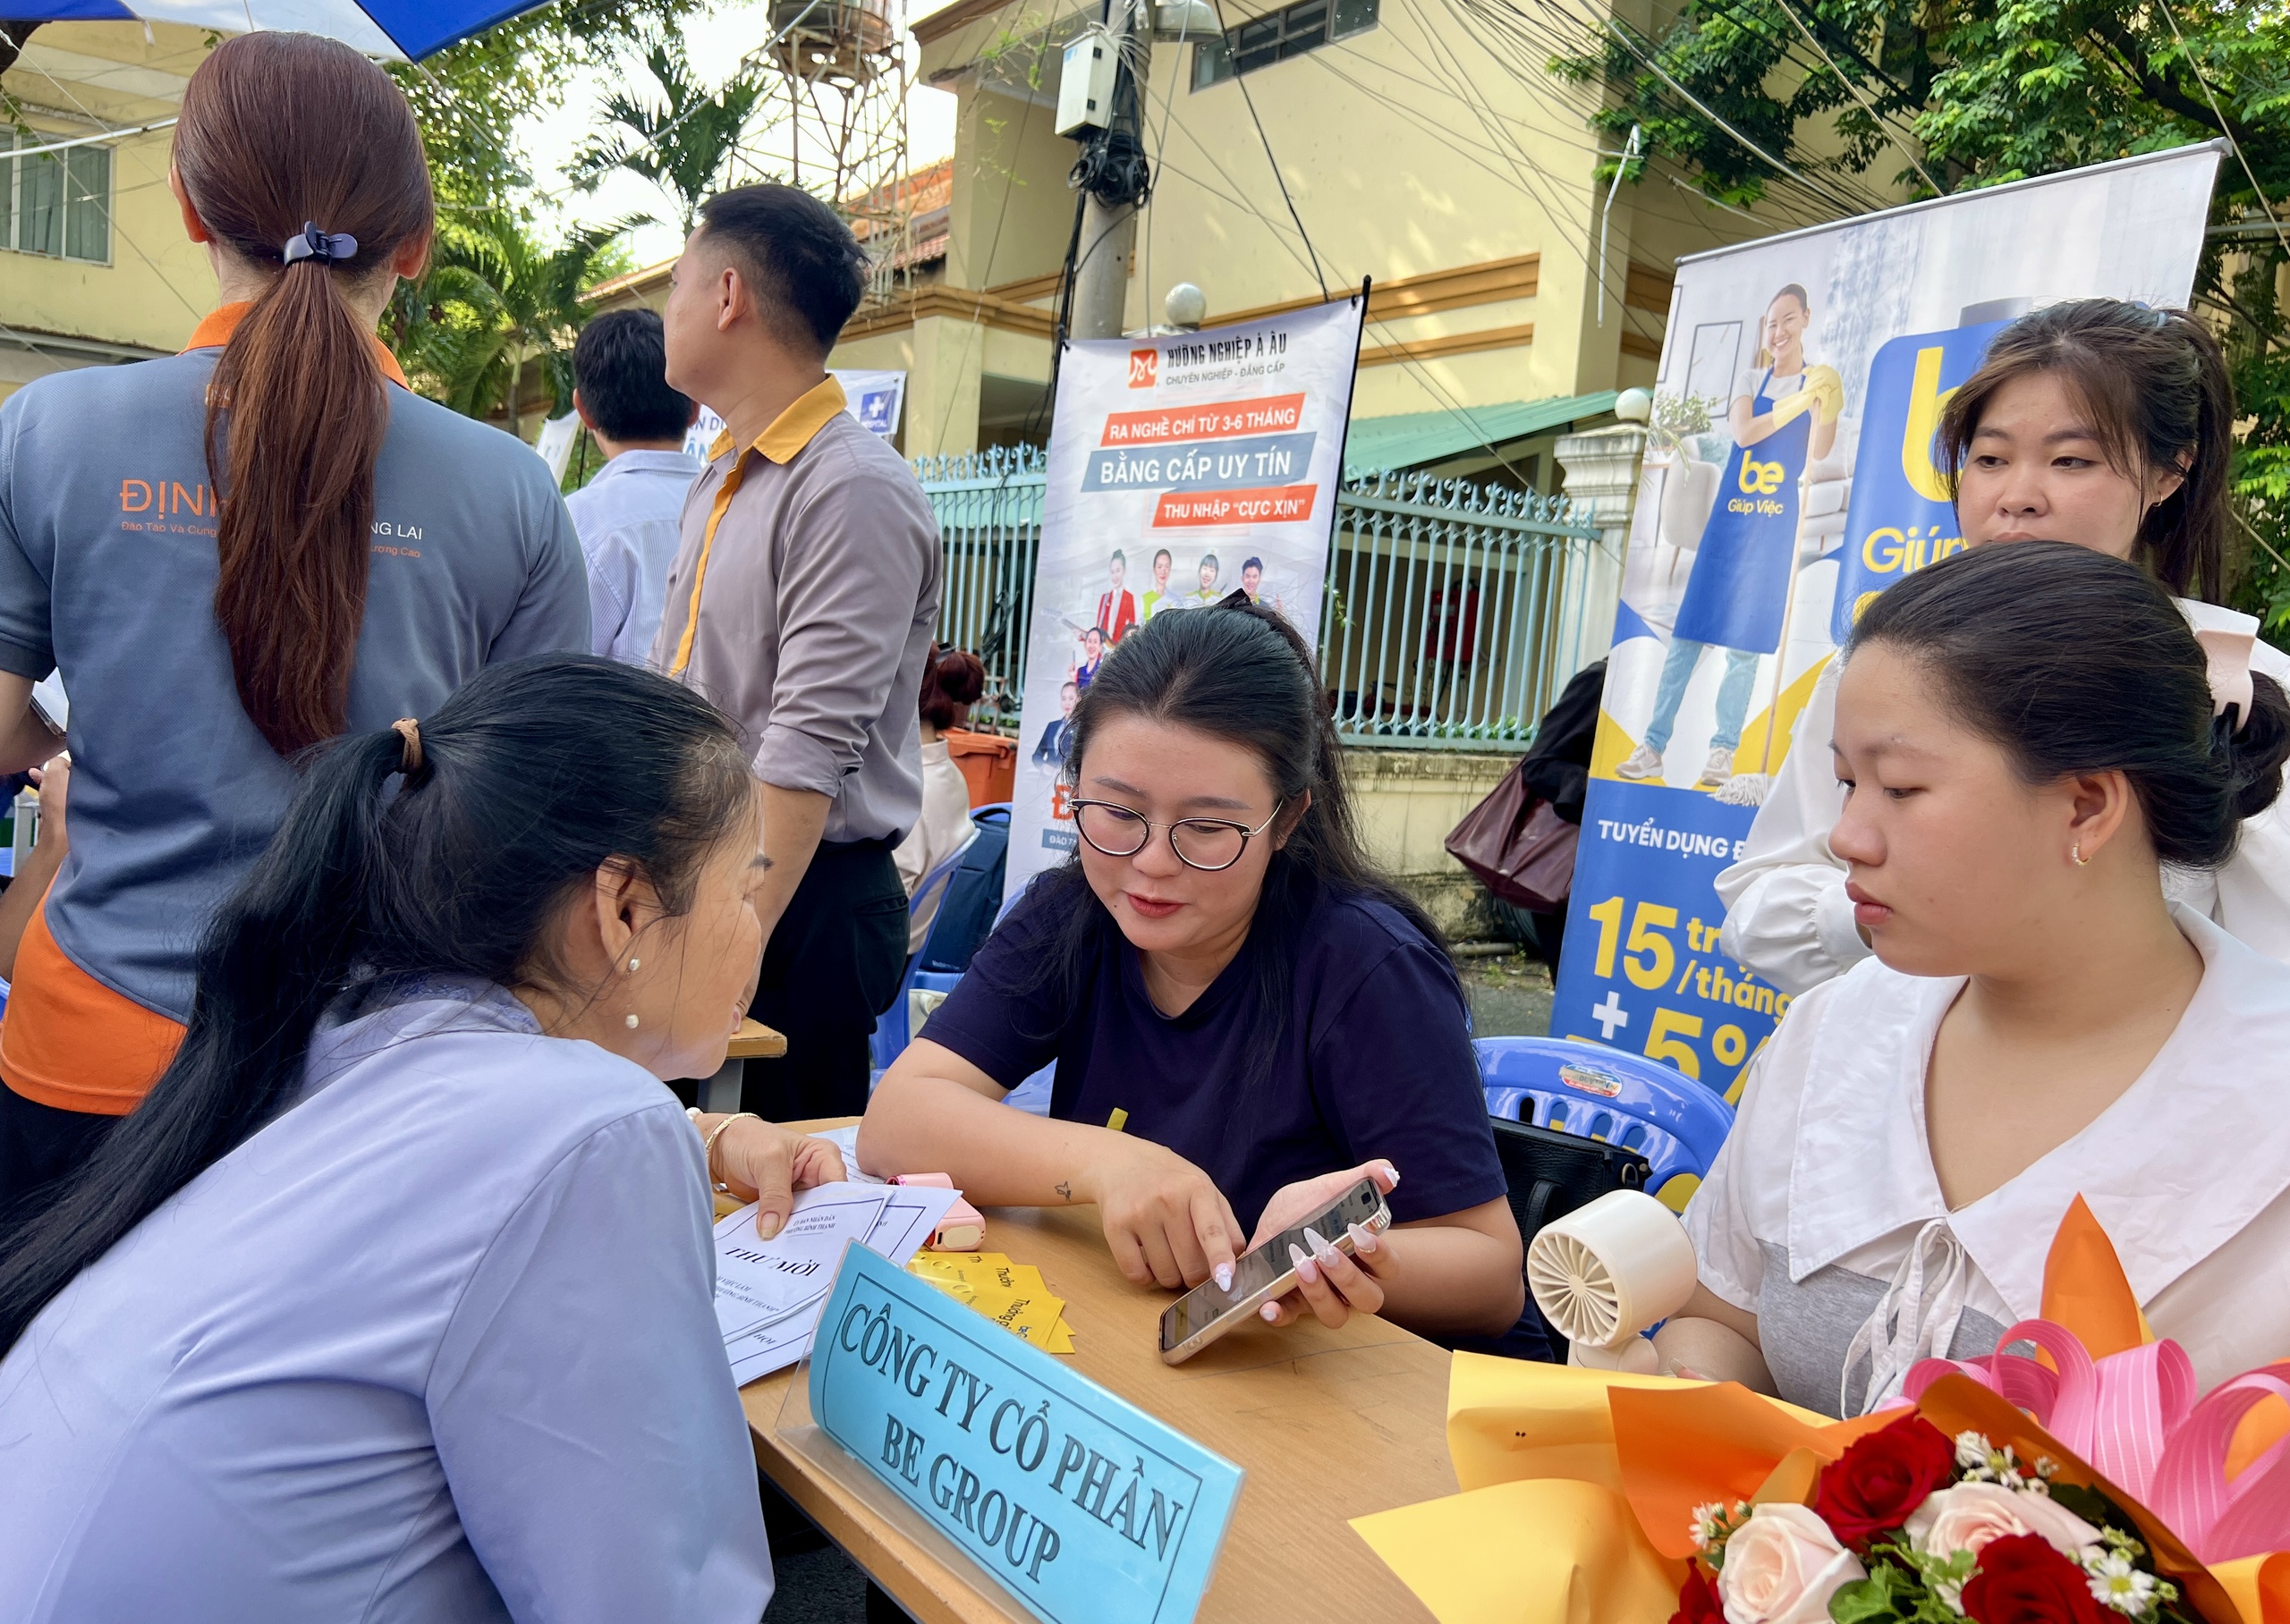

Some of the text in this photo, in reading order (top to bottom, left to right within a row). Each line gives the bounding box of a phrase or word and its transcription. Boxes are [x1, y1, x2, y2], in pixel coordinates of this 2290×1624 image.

[1209, 336, 1251, 365] NGHIỆP
[1269, 331, 1286, 356] ÂU
[1166, 371, 1199, 385] CHUYÊN
[1109, 425, 1128, 439] RA
[1131, 417, 1169, 438] NGHỀ
[1198, 414, 1219, 434] TỪ
[1222, 416, 1243, 431] 3-6
[1246, 407, 1295, 429] THÁNG
[1100, 445, 1291, 484] BẰNG CẤP UY TÍN
[1738, 450, 1785, 495] be
[1164, 503, 1190, 519] THU
[1192, 500, 1230, 520] NHẬP
[1727, 498, 1785, 519] Giúp Việc
[188, 525, 217, 538] Cung
[397, 524, 422, 540] LAI
[400, 546, 420, 558] Cao
[1598, 816, 1665, 849] TUYỂN
[1666, 830, 1729, 859] DỤNG
[1589, 895, 1679, 991] 15
[841, 1302, 1184, 1561] CÔNG TY CỔ PHẦN
[880, 1412, 1061, 1584] BE GROUP
